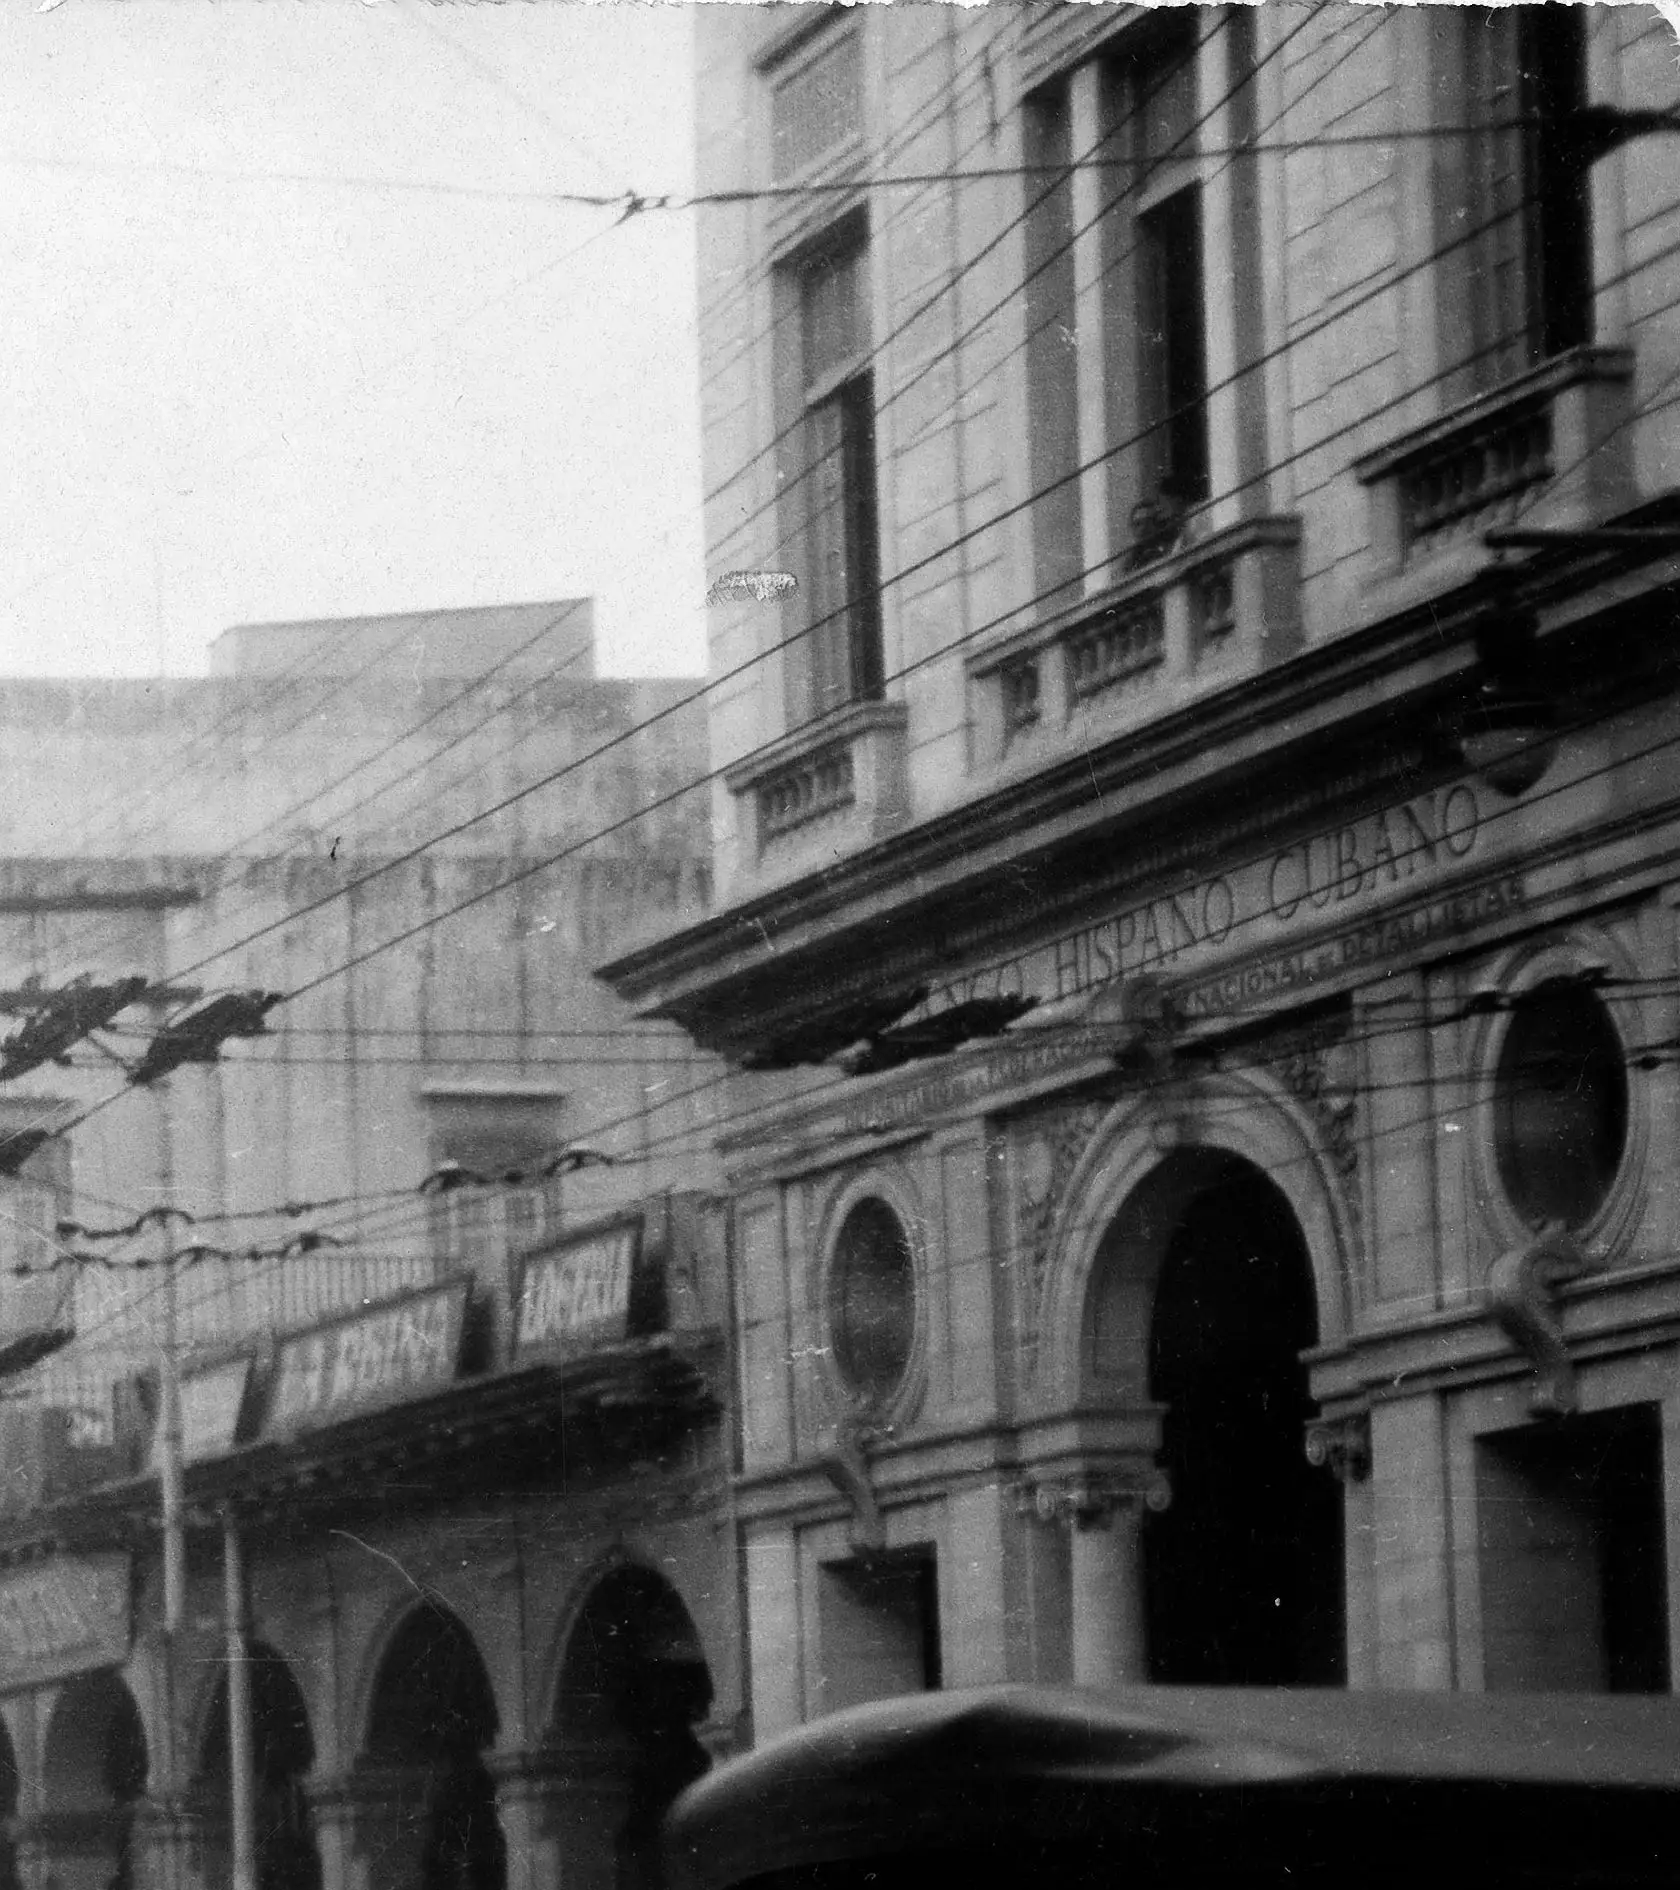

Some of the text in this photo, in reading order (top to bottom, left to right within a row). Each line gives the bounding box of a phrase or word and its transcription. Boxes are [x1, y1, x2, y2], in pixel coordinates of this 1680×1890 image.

[1054, 880, 1235, 998] HISPANO
[1270, 785, 1479, 920] CUBANO
[1191, 955, 1312, 1013] NACIONAL
